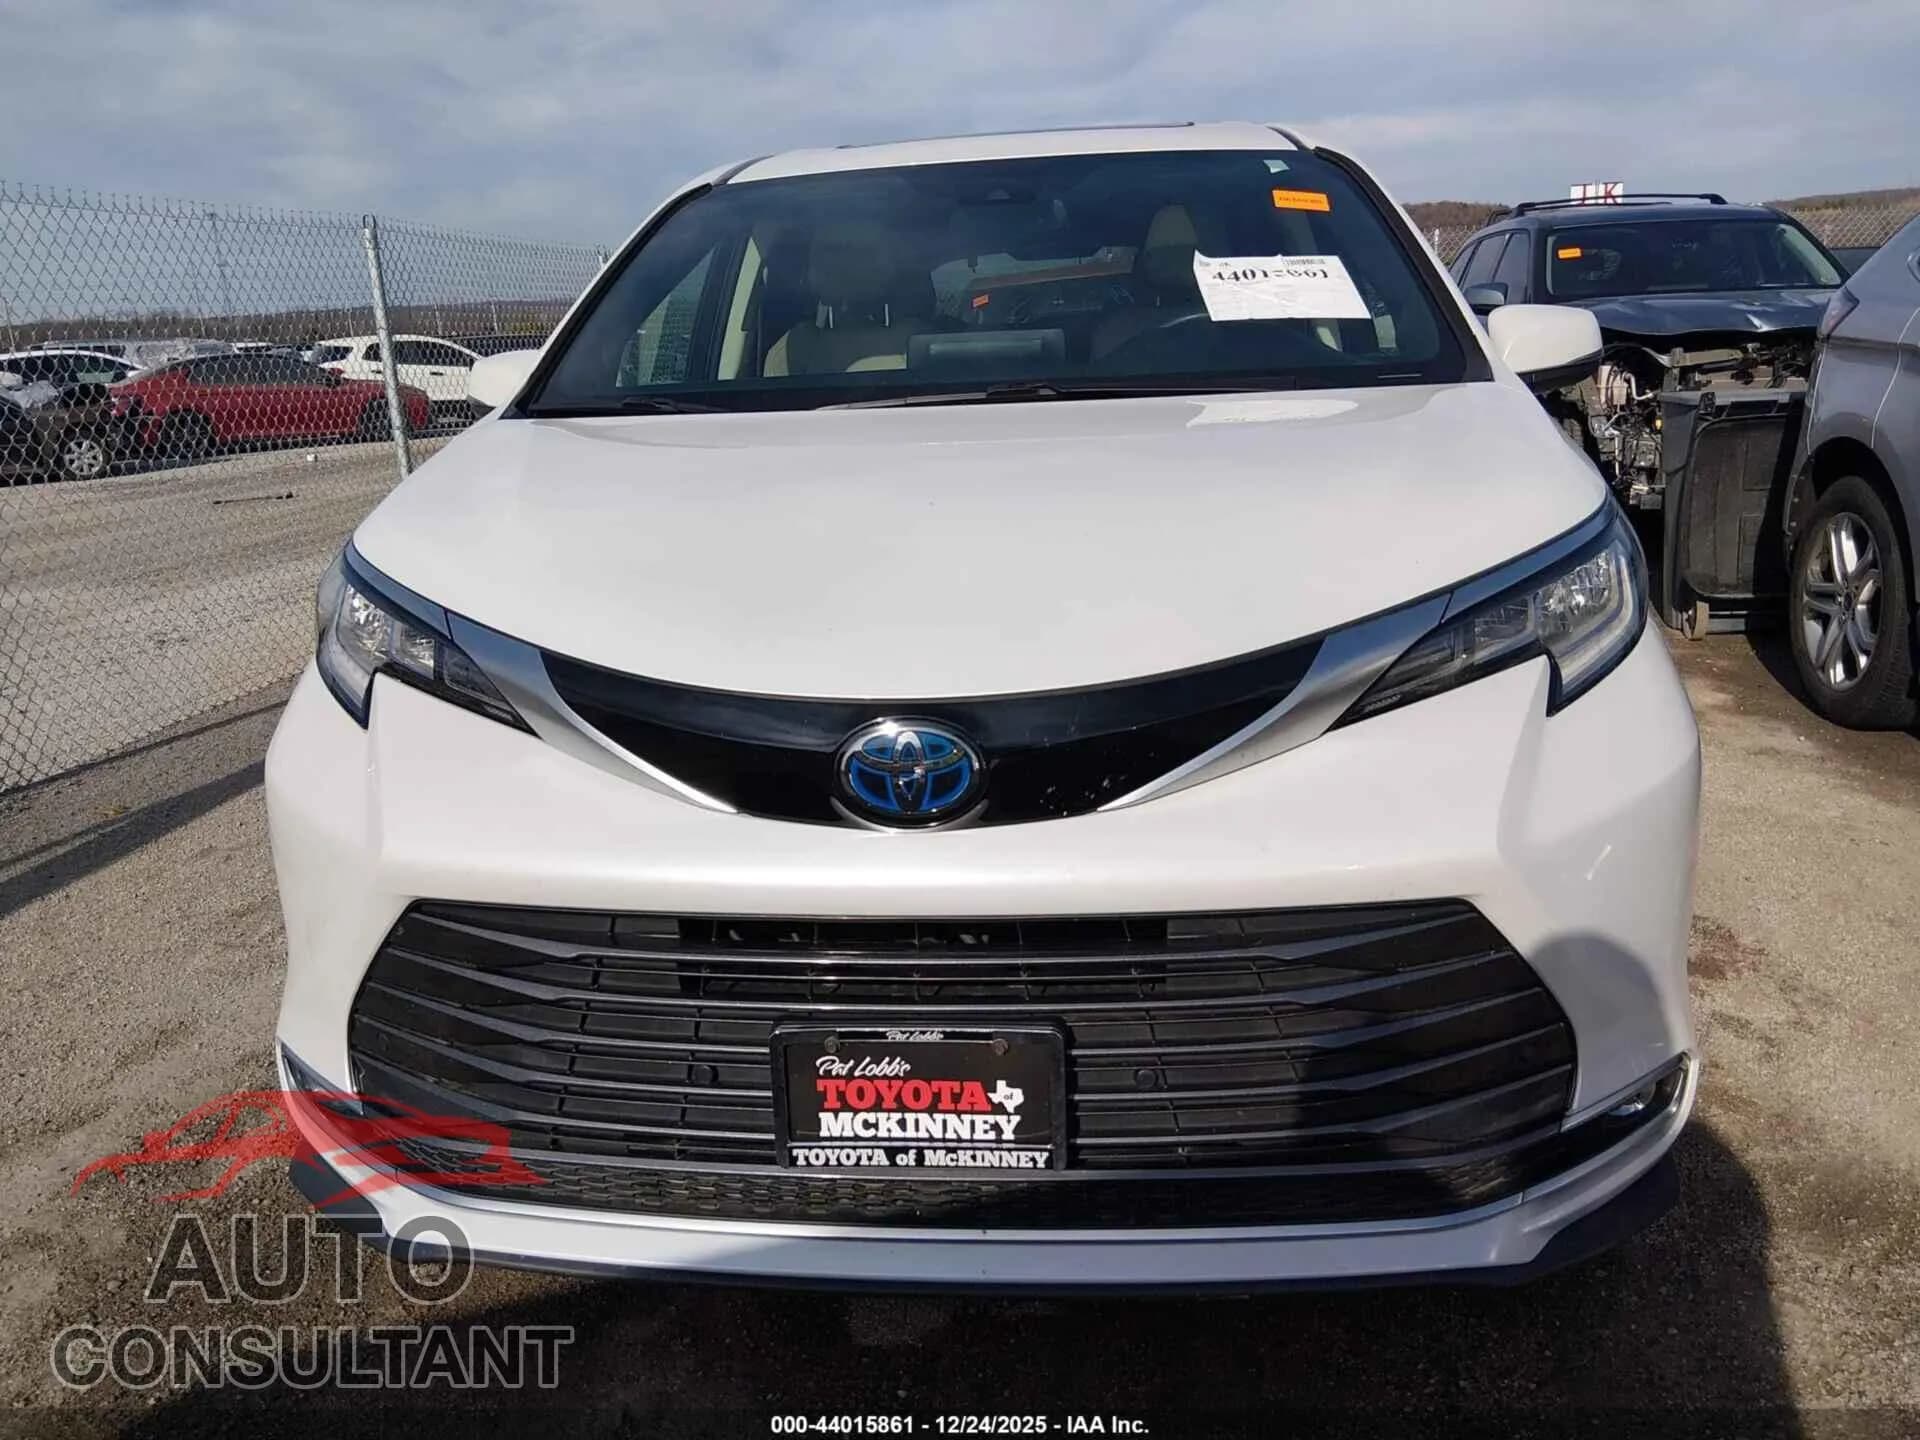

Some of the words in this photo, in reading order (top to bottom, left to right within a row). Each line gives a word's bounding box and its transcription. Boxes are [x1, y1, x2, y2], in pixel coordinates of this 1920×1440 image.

[1602, 182, 1623, 207] K
[815, 1055, 855, 1076] Pat
[853, 1055, 911, 1077] Lobb's
[816, 1079, 991, 1111] TOYOTA
[1003, 1093, 1014, 1101] of
[818, 1112, 1021, 1140] MCKINNEY
[792, 1148, 890, 1167] TOYOTA
[896, 1149, 917, 1167] of
[923, 1149, 1050, 1169] McKINNEY
